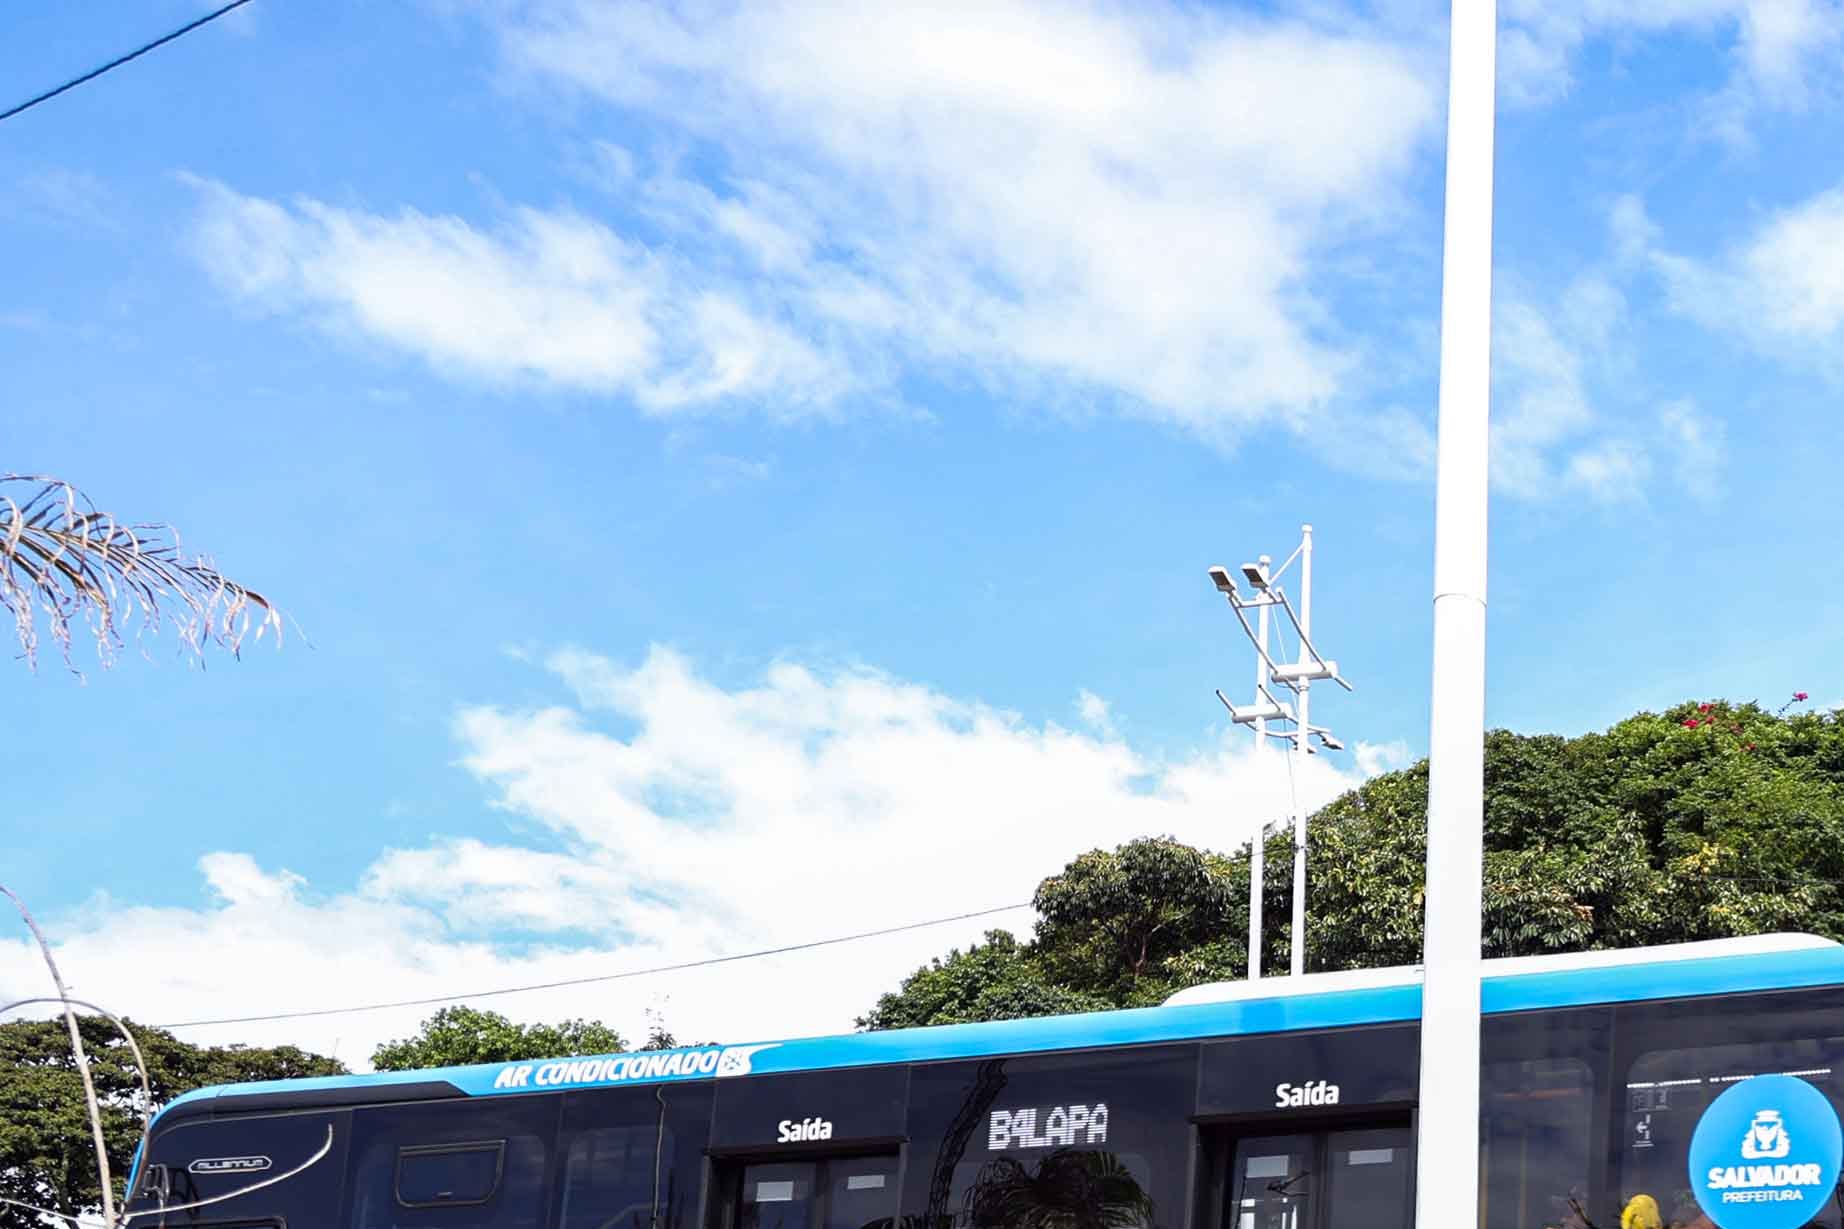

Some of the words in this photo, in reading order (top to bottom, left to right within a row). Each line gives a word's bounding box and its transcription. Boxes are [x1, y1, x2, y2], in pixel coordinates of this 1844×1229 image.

[494, 1065, 532, 1089] AR
[534, 1050, 719, 1085] CONDICIONADO
[1275, 1080, 1339, 1107] Saída
[777, 1117, 832, 1143] Saída
[1707, 1163, 1821, 1189] SALVADOR
[1722, 1189, 1803, 1203] PREFEITURA
